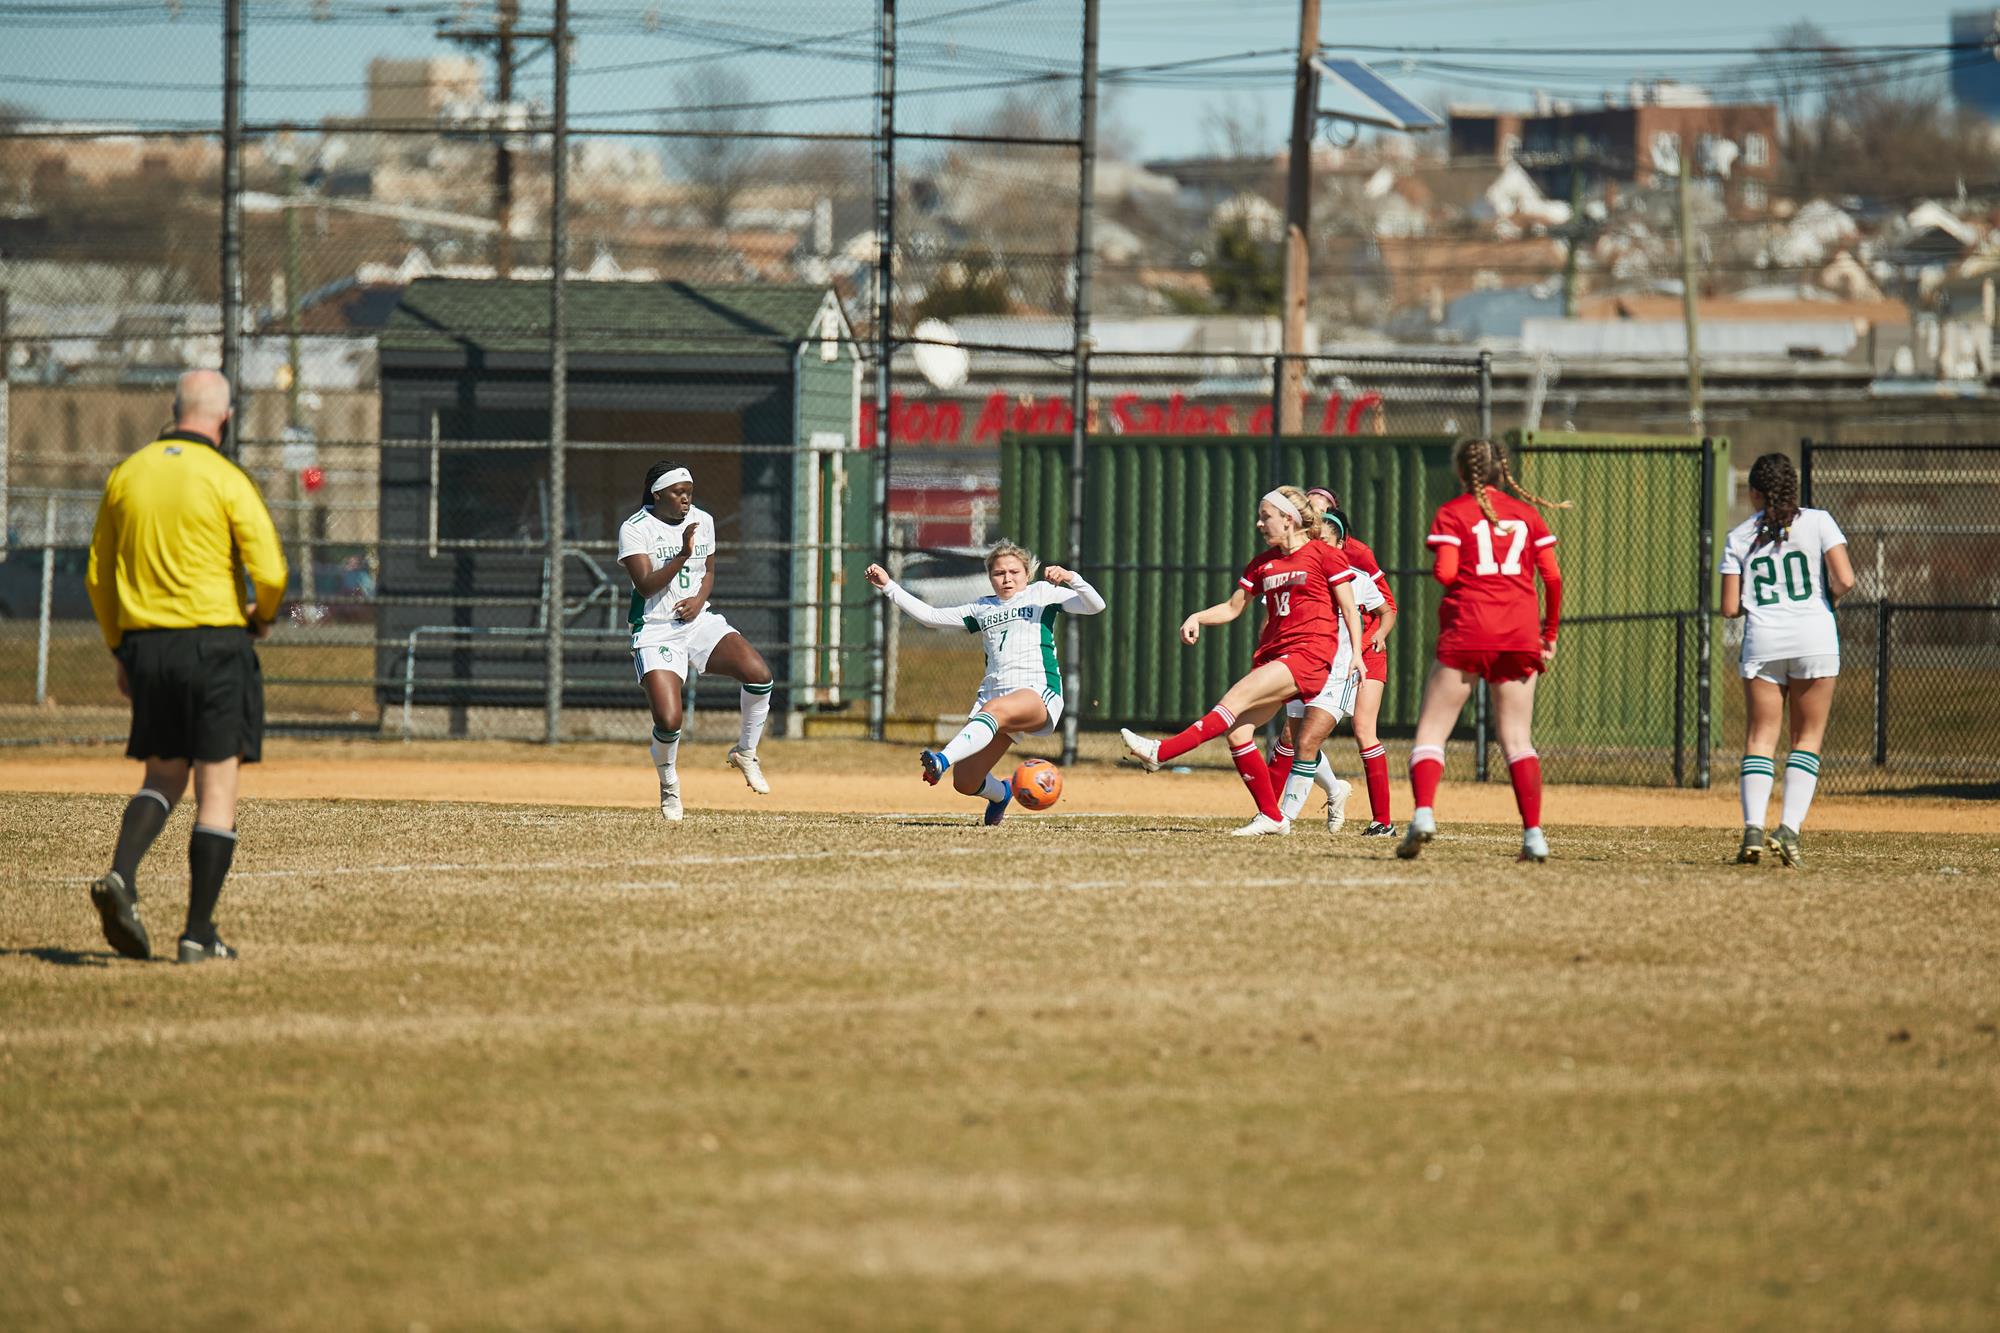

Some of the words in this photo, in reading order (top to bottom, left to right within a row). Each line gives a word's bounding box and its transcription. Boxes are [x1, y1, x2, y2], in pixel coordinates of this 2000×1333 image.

[1471, 519, 1528, 576] 17
[679, 565, 690, 589] 6
[1750, 550, 1812, 606] 20
[1011, 606, 1034, 618] CITY
[1273, 591, 1290, 617] 18
[999, 629, 1008, 652] 7
